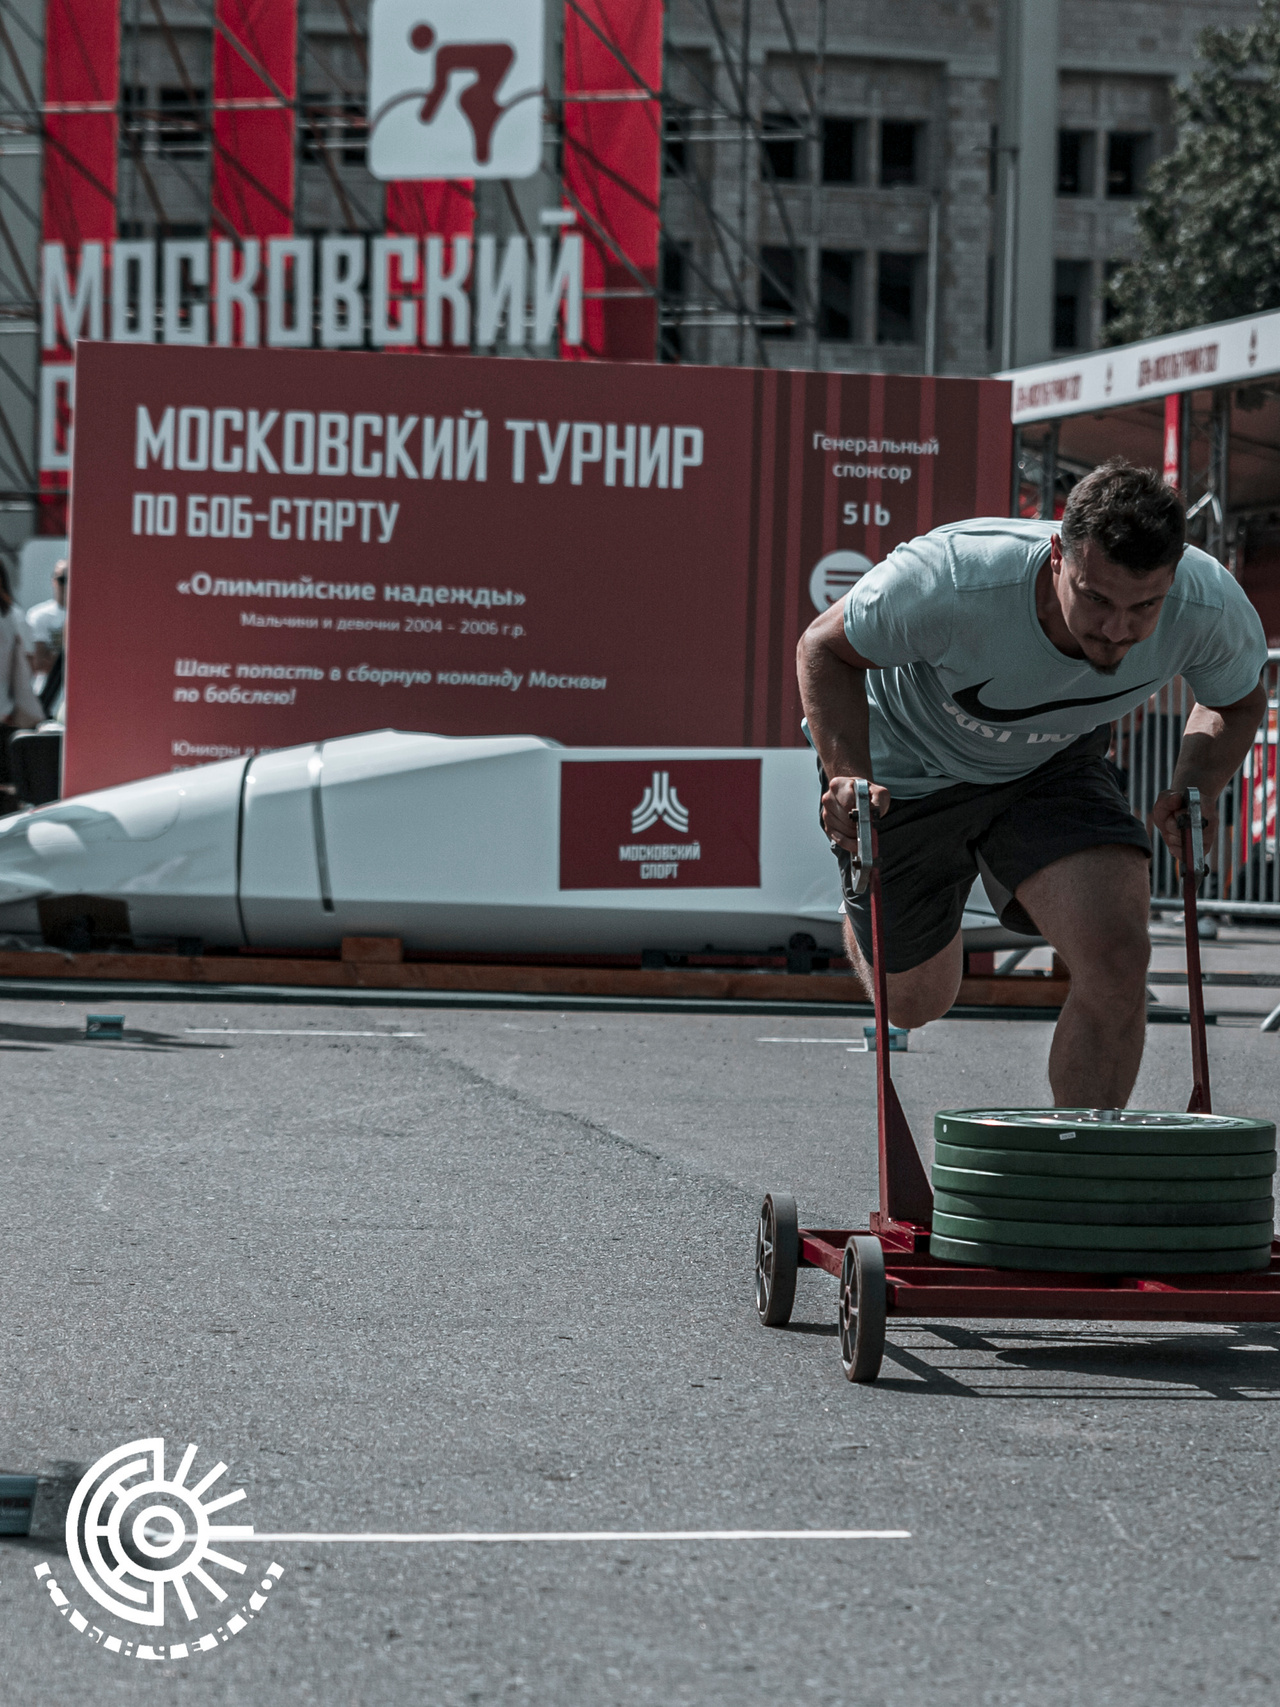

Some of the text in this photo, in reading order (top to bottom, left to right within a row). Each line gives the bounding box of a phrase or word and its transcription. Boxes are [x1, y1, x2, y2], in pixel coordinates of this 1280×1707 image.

[42, 210, 583, 350] МОСКОВСКИЙ
[135, 405, 489, 482] МОСКОВСКИЙ
[505, 419, 704, 489] ТУРНИР
[812, 430, 940, 456] Генеральный
[832, 462, 912, 484] спонсор
[132, 493, 400, 544] ПО БОБ-СТАРТУ
[177, 572, 526, 608] «Олимпийские надежды»
[322, 617, 332, 629] и
[404, 618, 443, 633] 2004
[460, 620, 498, 636] 2006
[174, 658, 608, 692] Шанс попасть в сборную команду Москвы
[173, 683, 297, 705] по бобслею!
[619, 841, 701, 861] МОСКОВСКИЙ
[640, 863, 679, 879] СПОРТ
